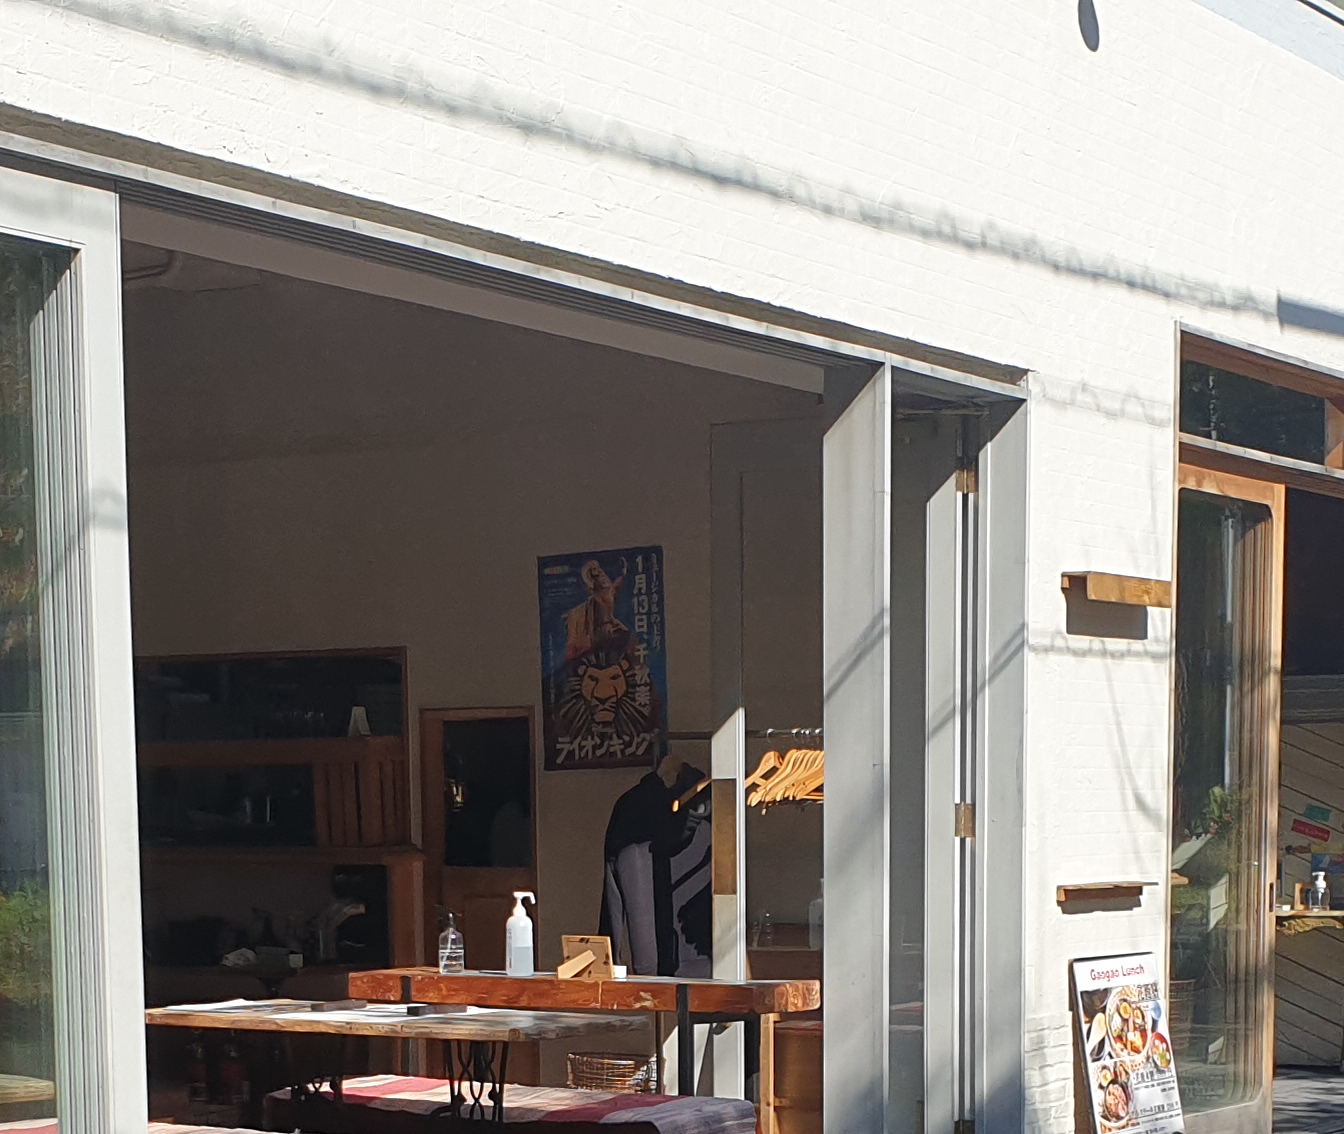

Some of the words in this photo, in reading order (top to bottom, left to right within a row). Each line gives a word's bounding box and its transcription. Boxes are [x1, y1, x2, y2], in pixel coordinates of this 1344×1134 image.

[556, 733, 652, 764] ライオンキング
